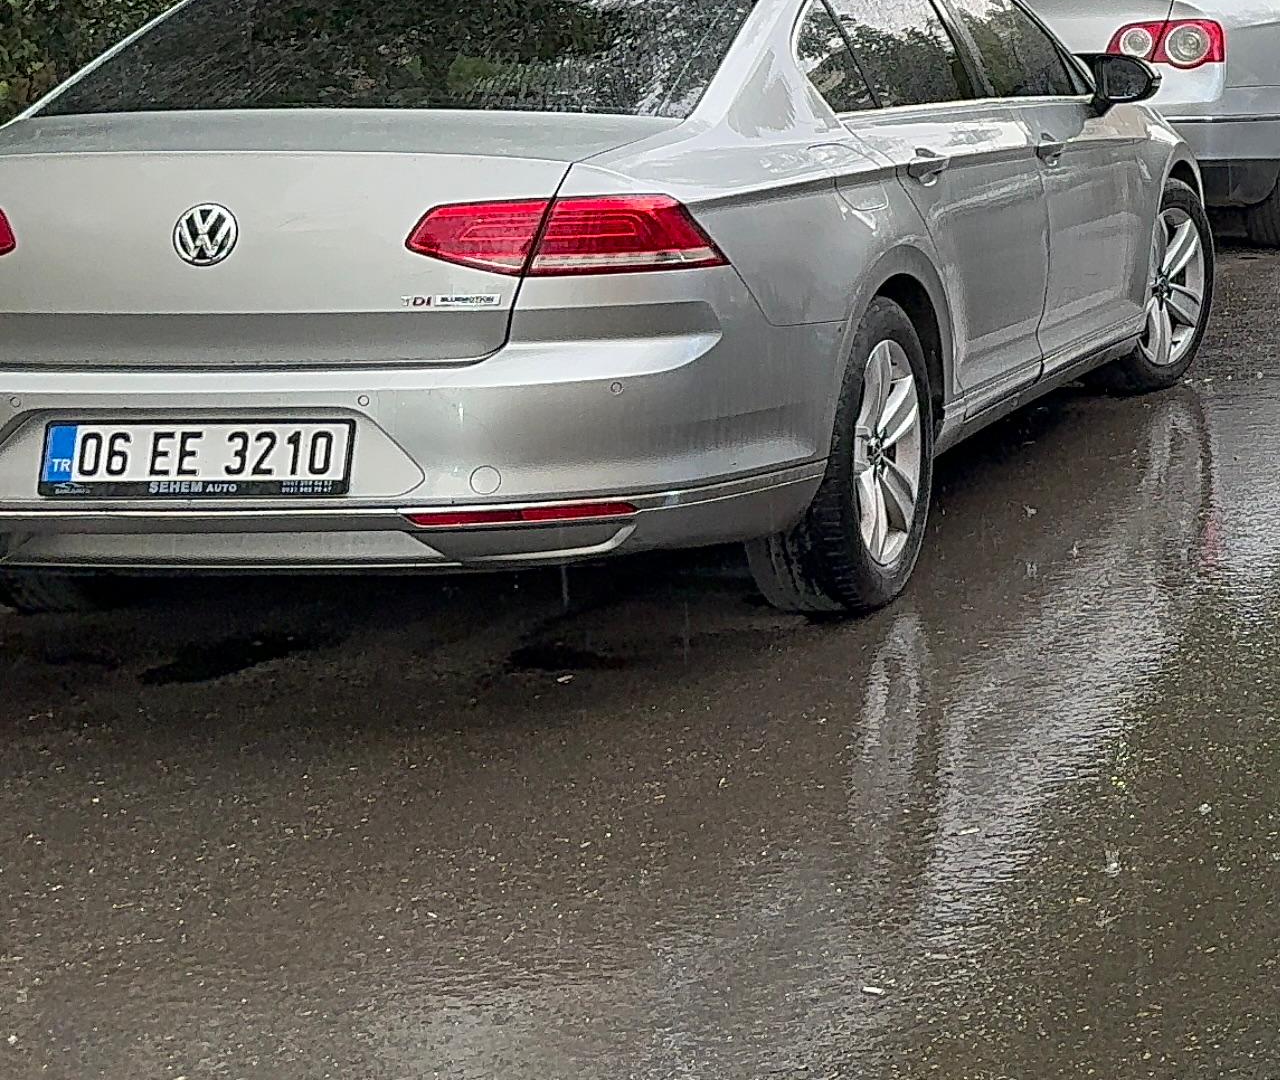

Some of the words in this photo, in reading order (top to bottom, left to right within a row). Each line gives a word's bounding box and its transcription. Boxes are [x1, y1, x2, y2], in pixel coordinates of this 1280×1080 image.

[52, 458, 71, 472] TR
[78, 431, 131, 476] 06
[150, 431, 204, 476] EE
[225, 430, 335, 476] 3210
[149, 481, 203, 494] SEHEM
[206, 483, 238, 493] AUTO
